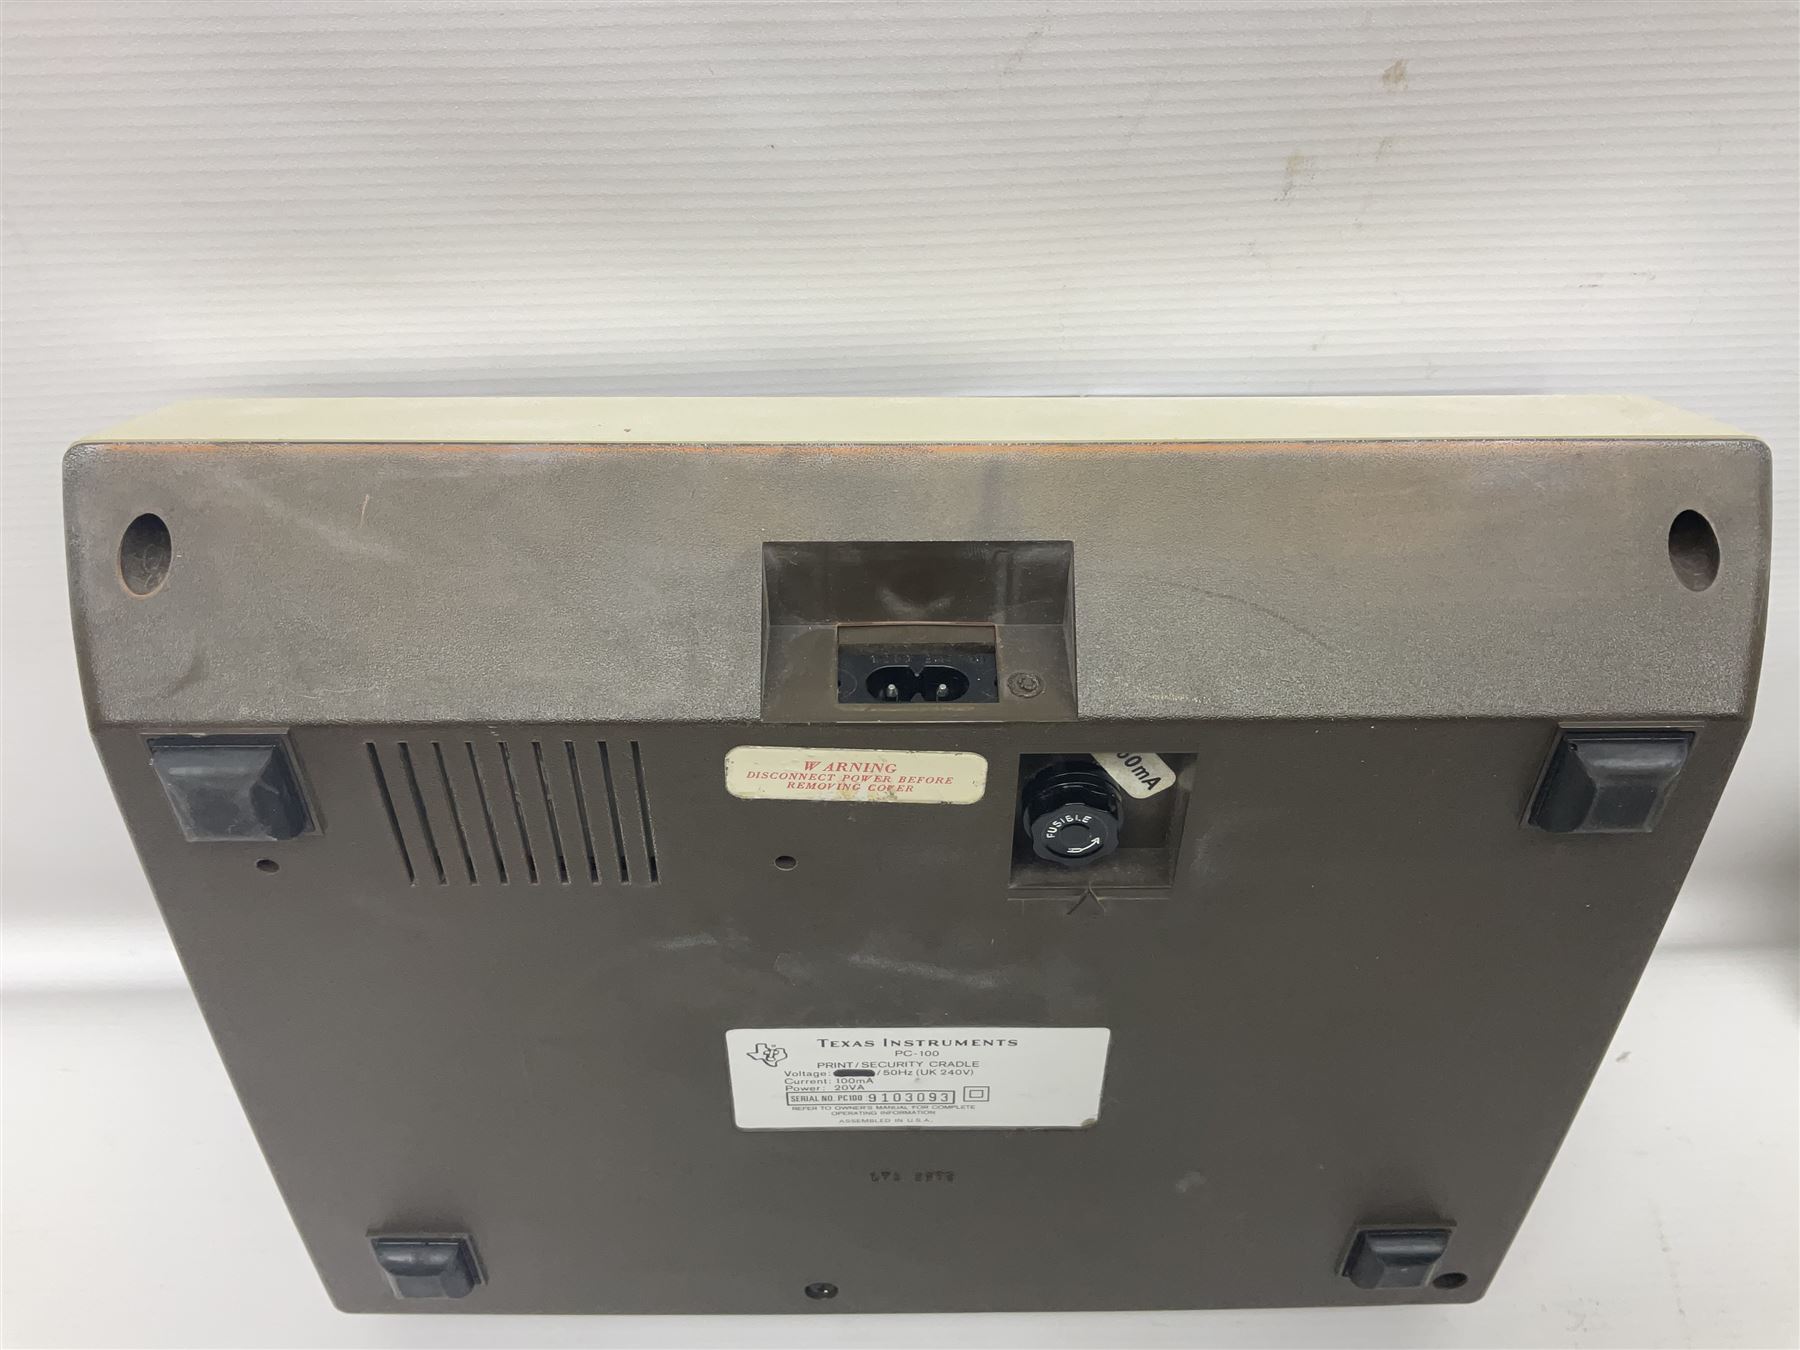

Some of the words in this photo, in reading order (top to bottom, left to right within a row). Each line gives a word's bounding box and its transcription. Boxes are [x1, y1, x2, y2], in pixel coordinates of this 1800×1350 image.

[804, 760, 898, 774] WARNING
[746, 771, 836, 781] DISCONNECT
[842, 774, 893, 783] POWER
[898, 776, 954, 785] BEFORE
[787, 781, 861, 791] REMOVING
[867, 784, 914, 793] COVER
[1046, 814, 1092, 839] FUSIBLE
[817, 1038, 875, 1048] TEXAS
[883, 1038, 1018, 1047] INSTRUMENTS
[785, 1070, 832, 1078] Voltage:
[868, 1093, 949, 1103] 9103093
